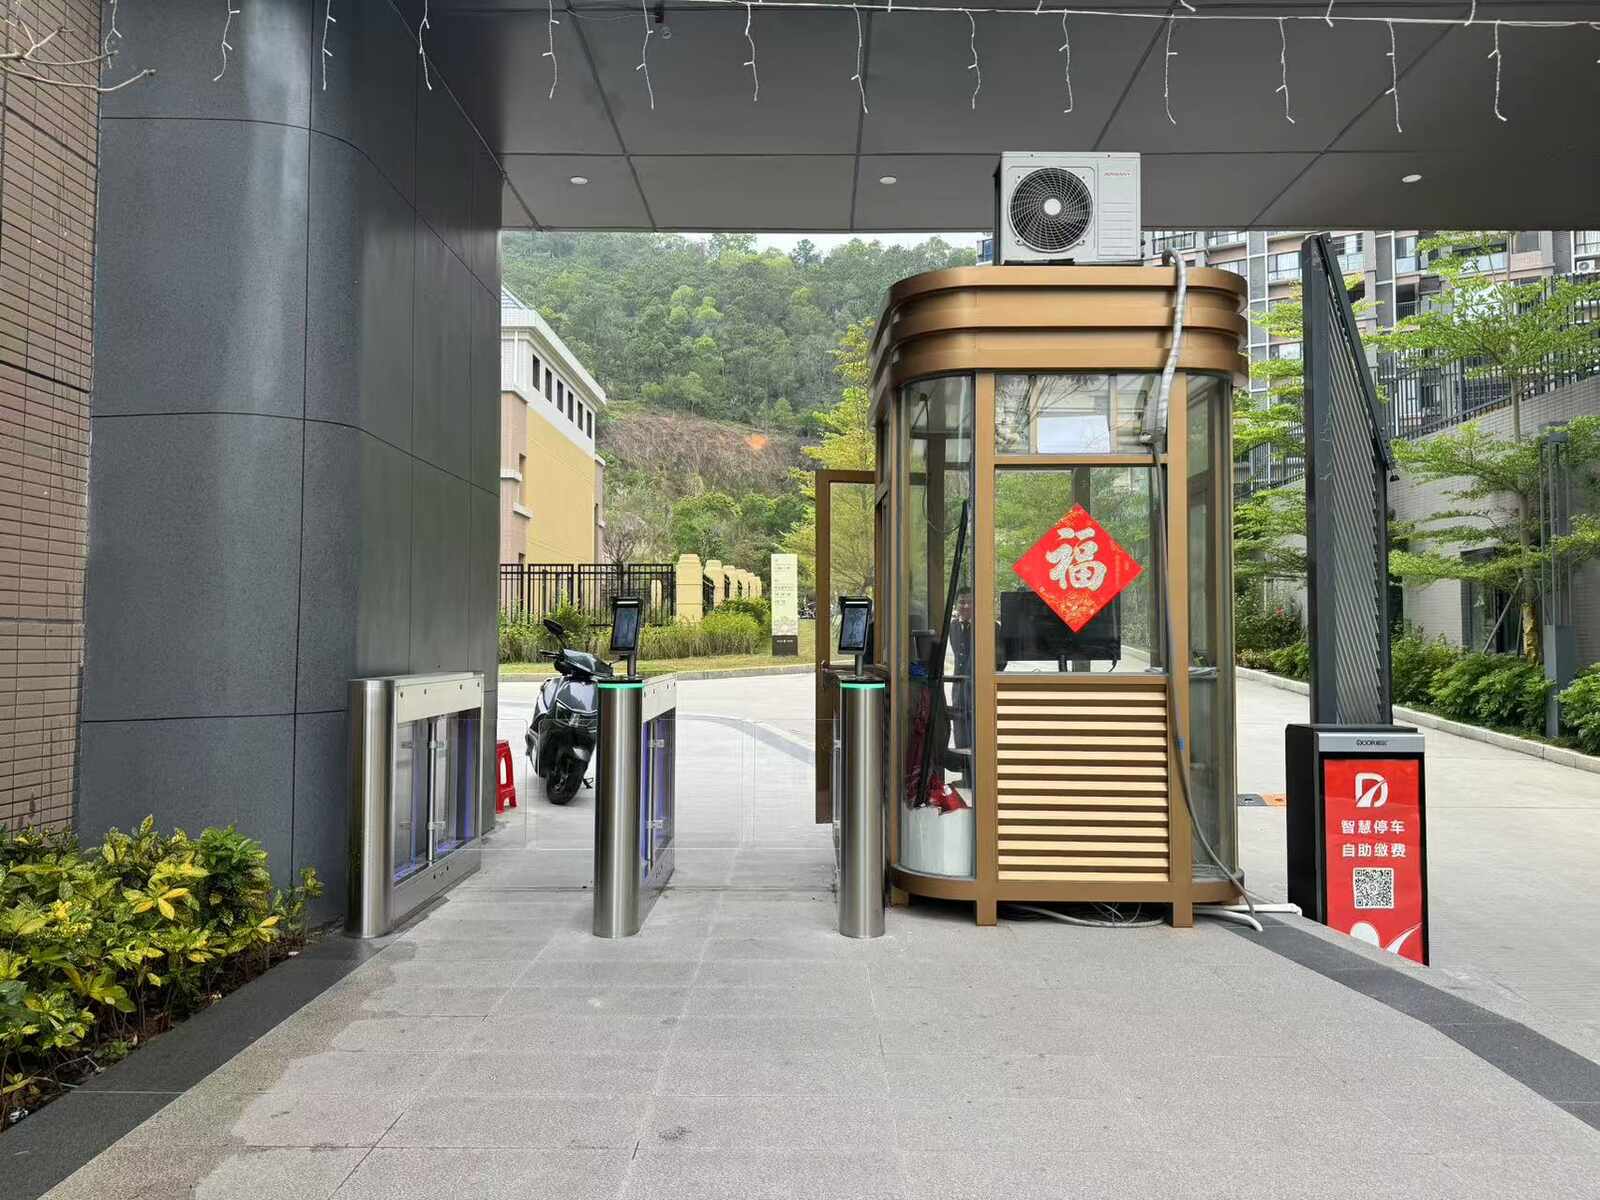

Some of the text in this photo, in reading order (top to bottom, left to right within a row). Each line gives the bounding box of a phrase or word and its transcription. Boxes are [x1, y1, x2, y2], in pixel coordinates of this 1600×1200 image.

[1045, 527, 1107, 592] 福
[1341, 819, 1406, 834] 智慧停车
[1342, 842, 1407, 858] 自助缴费
